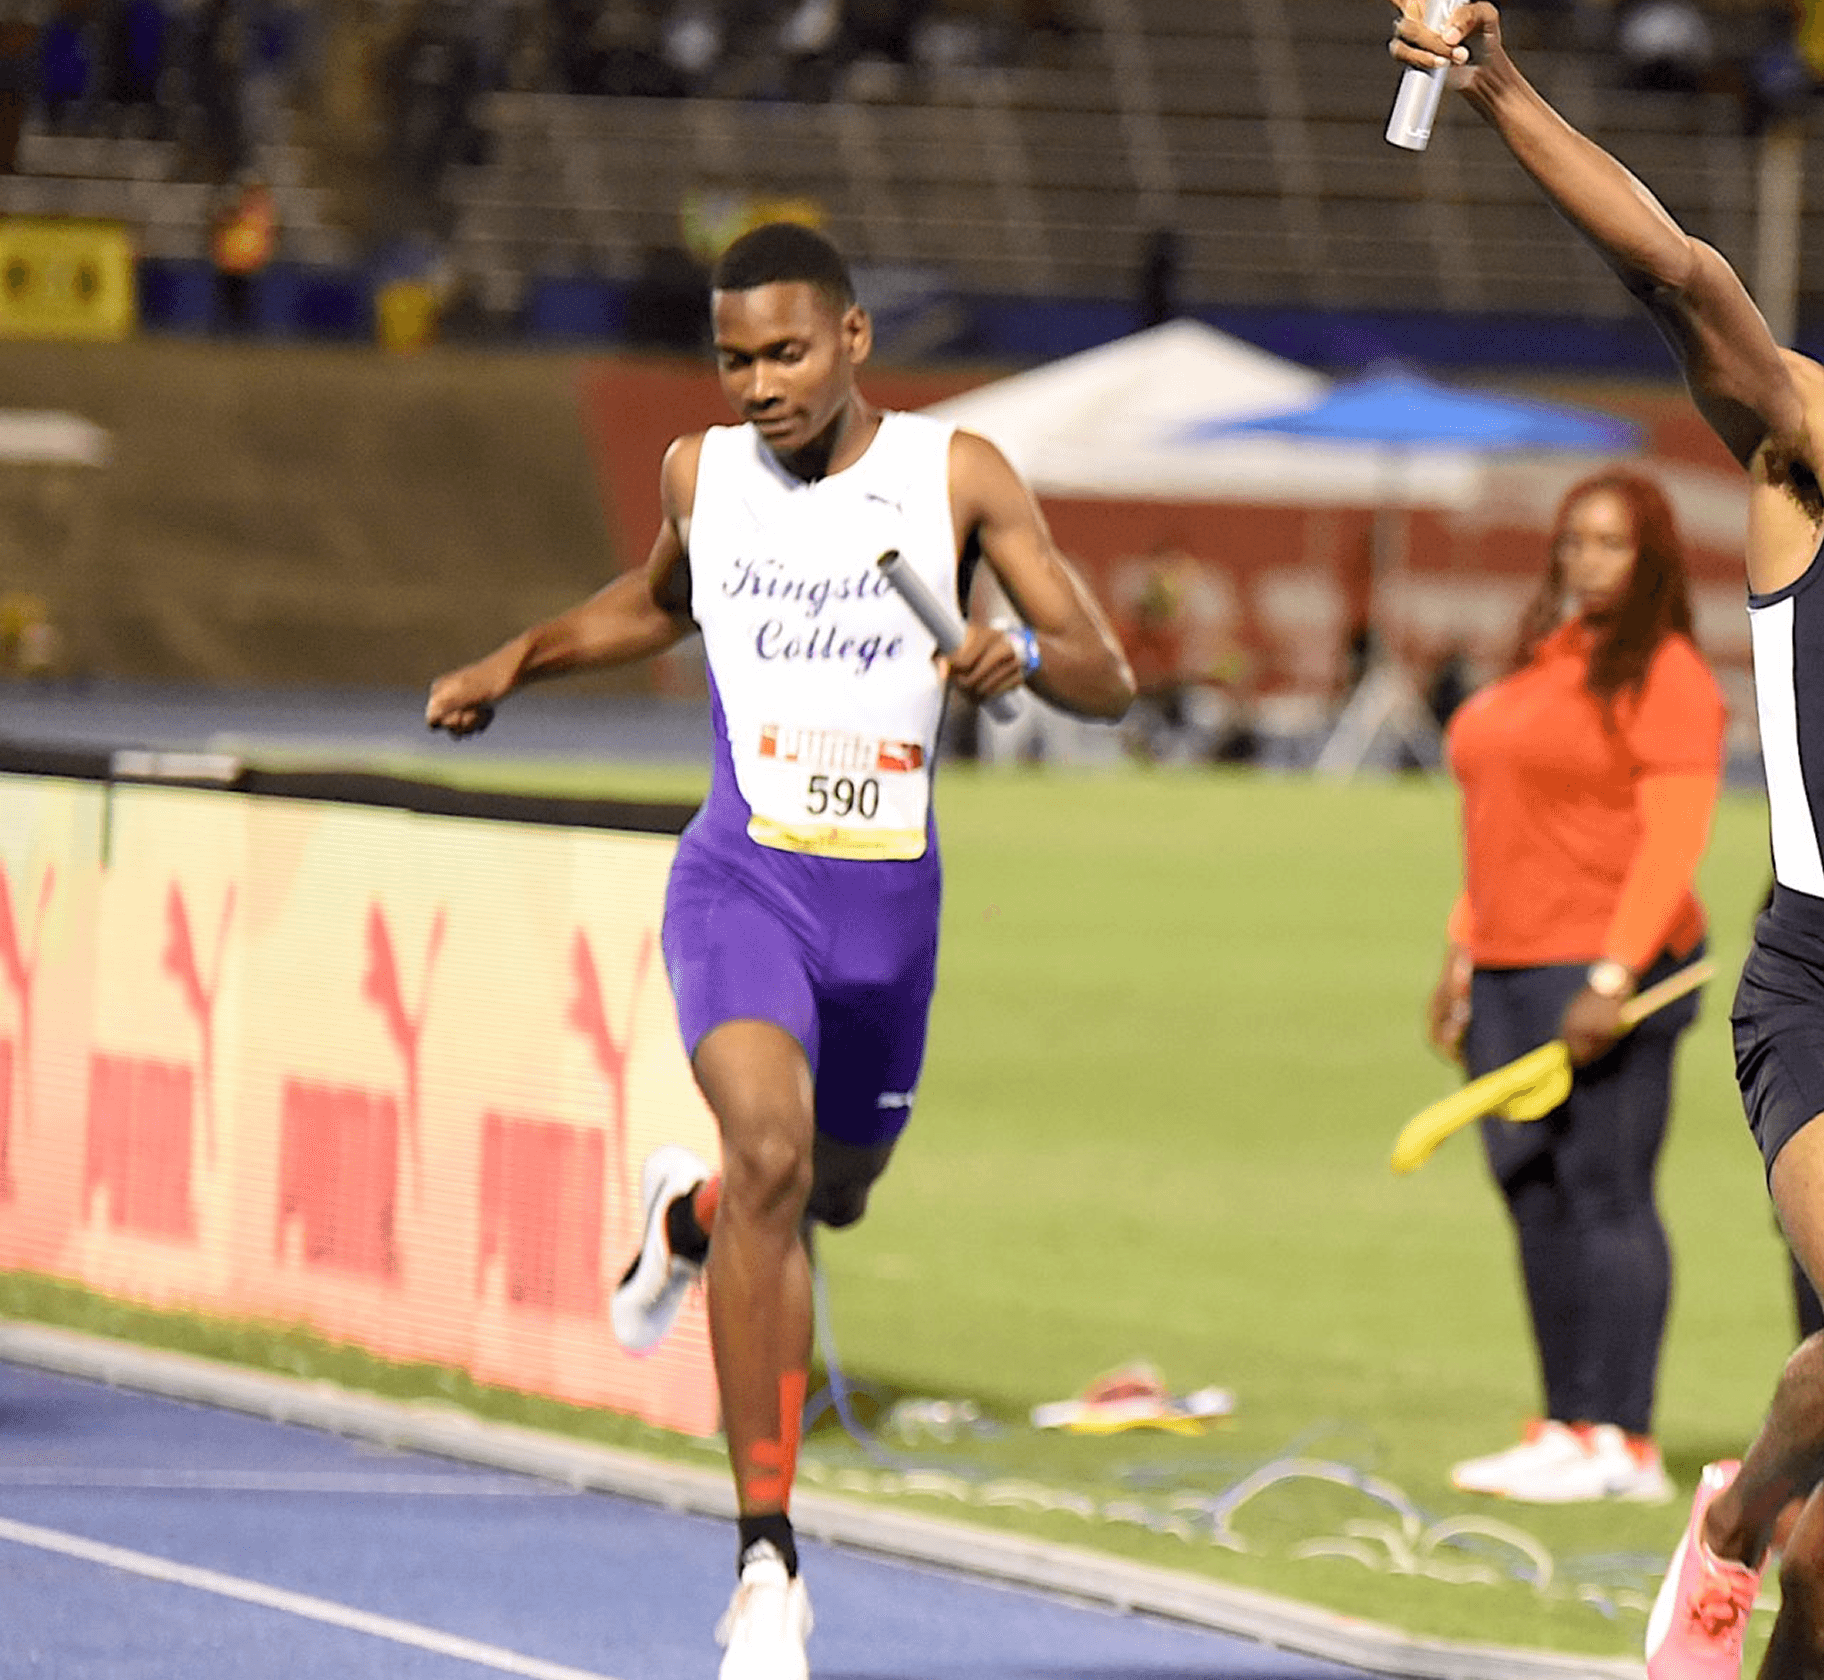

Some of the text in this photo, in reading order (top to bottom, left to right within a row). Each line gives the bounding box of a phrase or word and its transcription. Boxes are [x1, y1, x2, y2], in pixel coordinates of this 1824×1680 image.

[721, 558, 892, 618] Kingsto
[755, 619, 904, 676] College
[806, 775, 880, 820] 590
